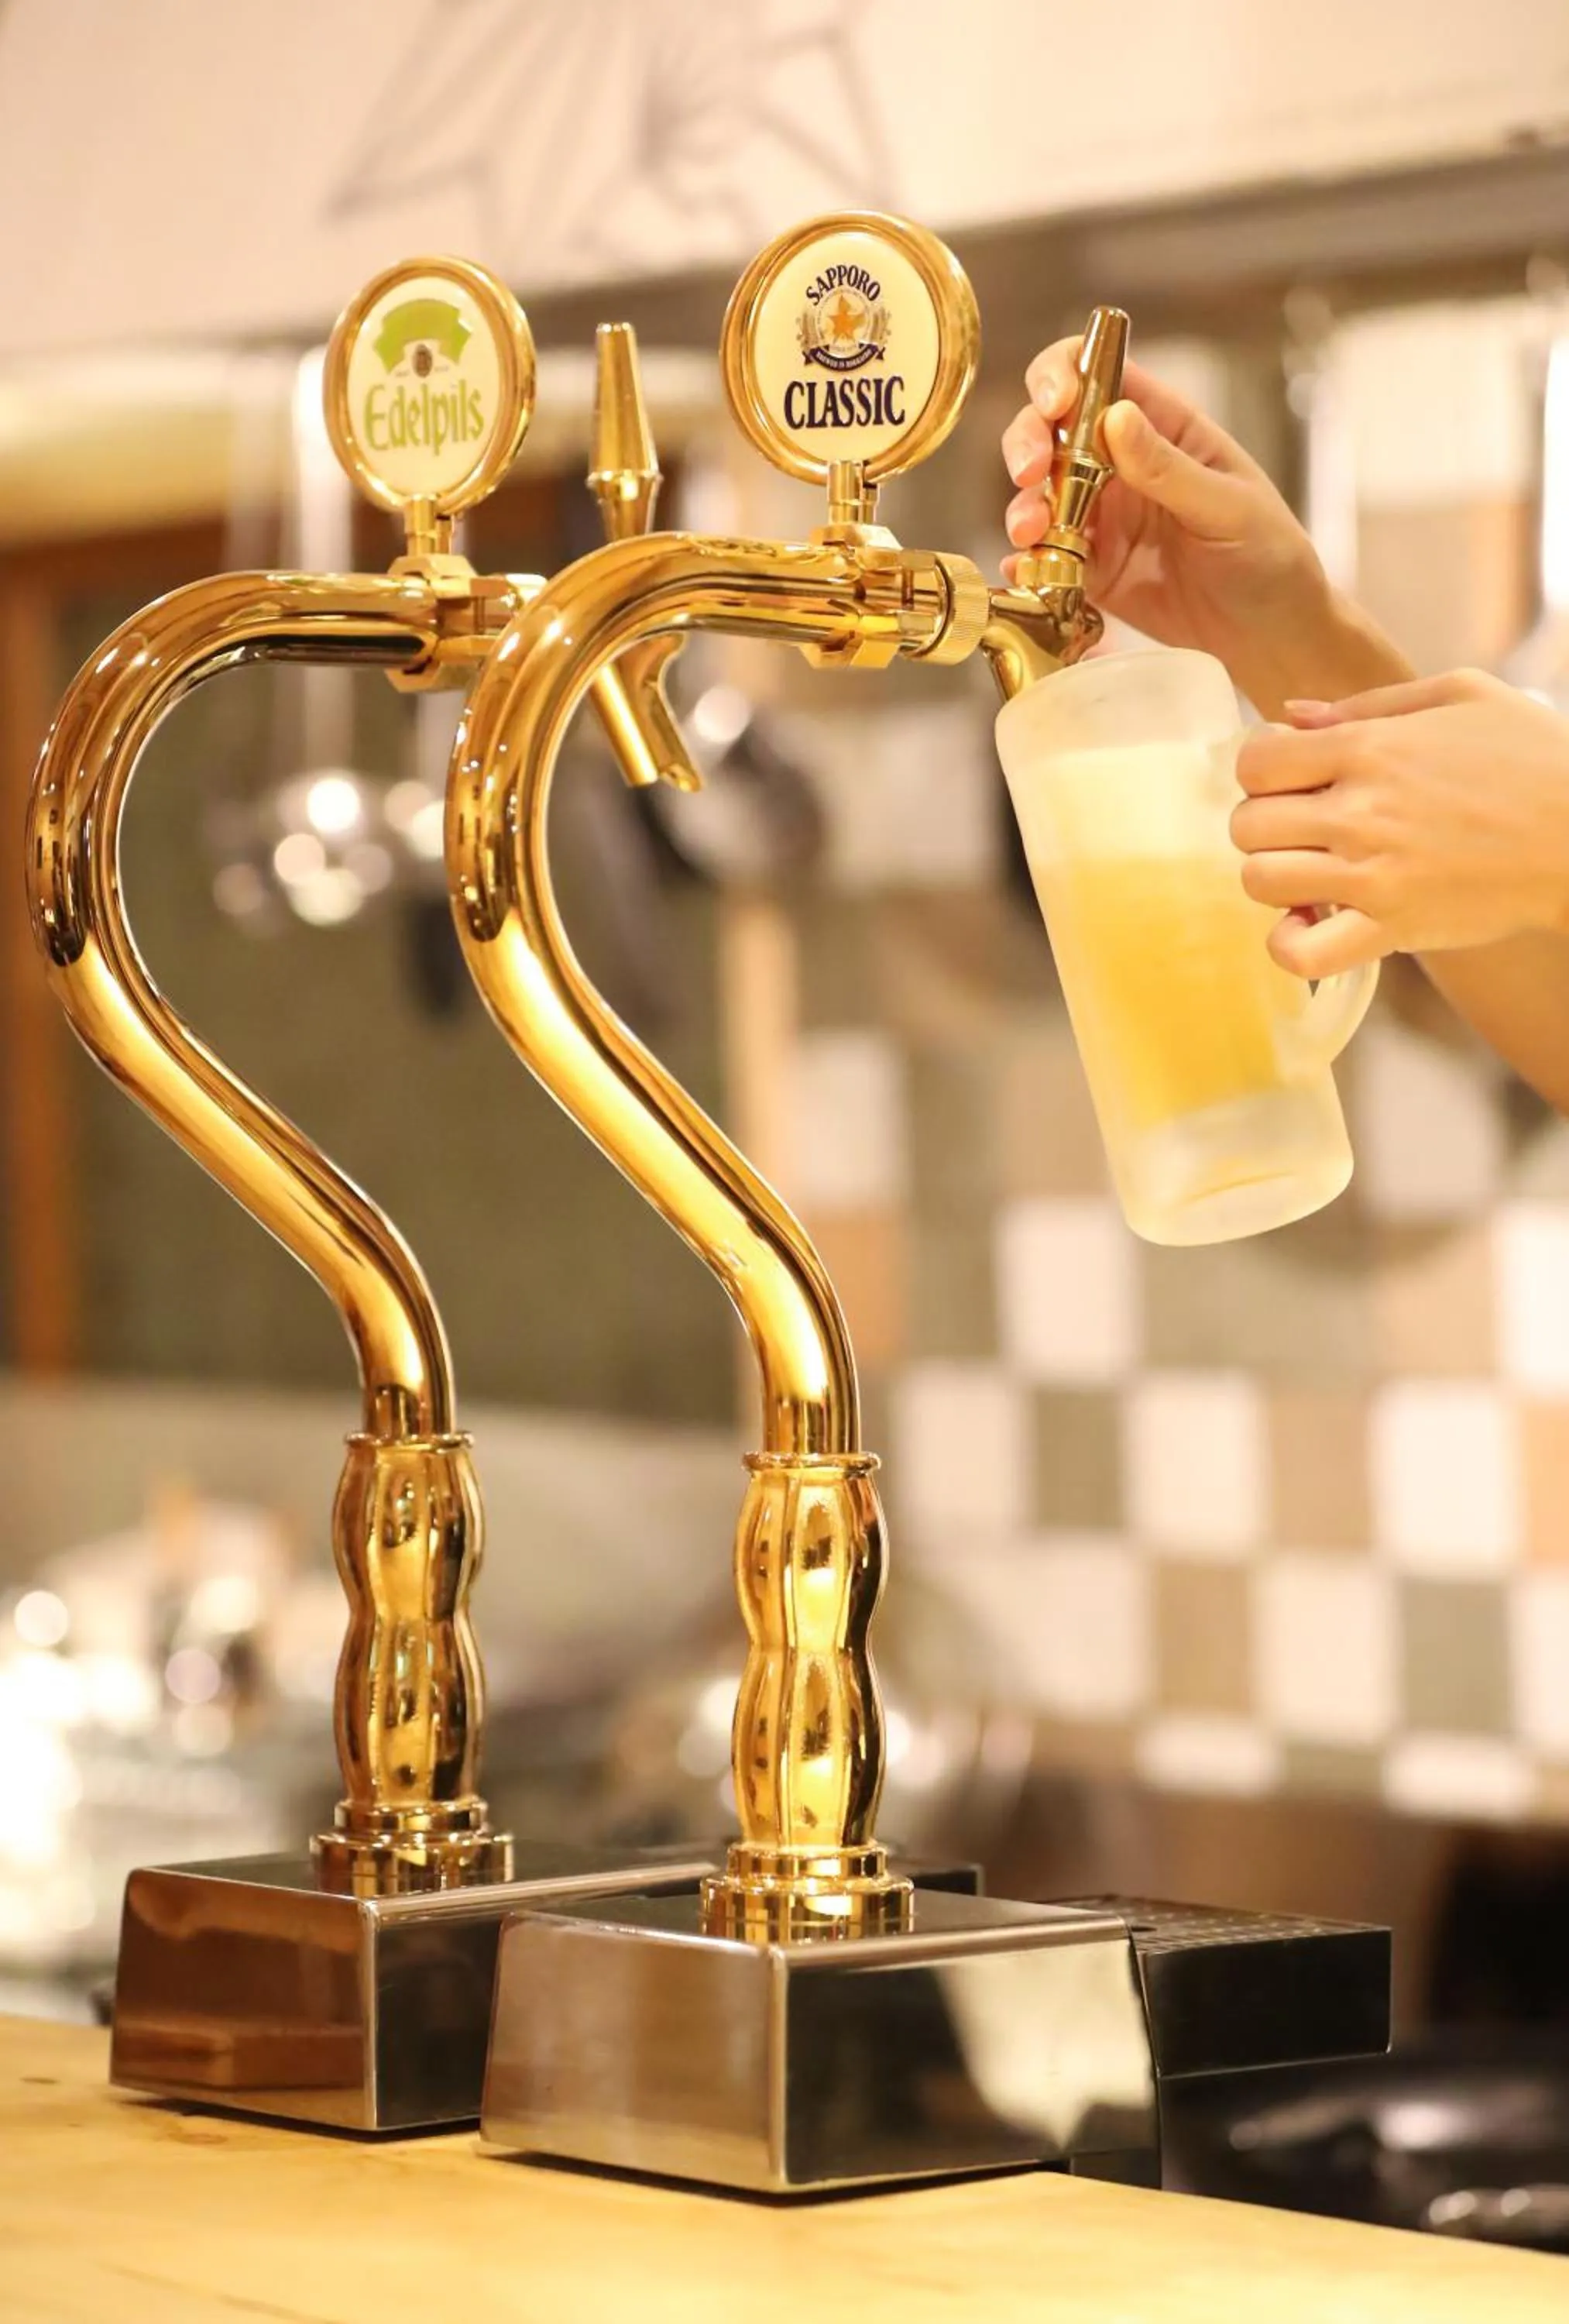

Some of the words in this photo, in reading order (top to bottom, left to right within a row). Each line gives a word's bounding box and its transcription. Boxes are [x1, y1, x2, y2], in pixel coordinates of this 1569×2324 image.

[806, 264, 880, 305] SAPPORO
[364, 379, 484, 456] Edelpils
[784, 376, 905, 429] CLASSIC
